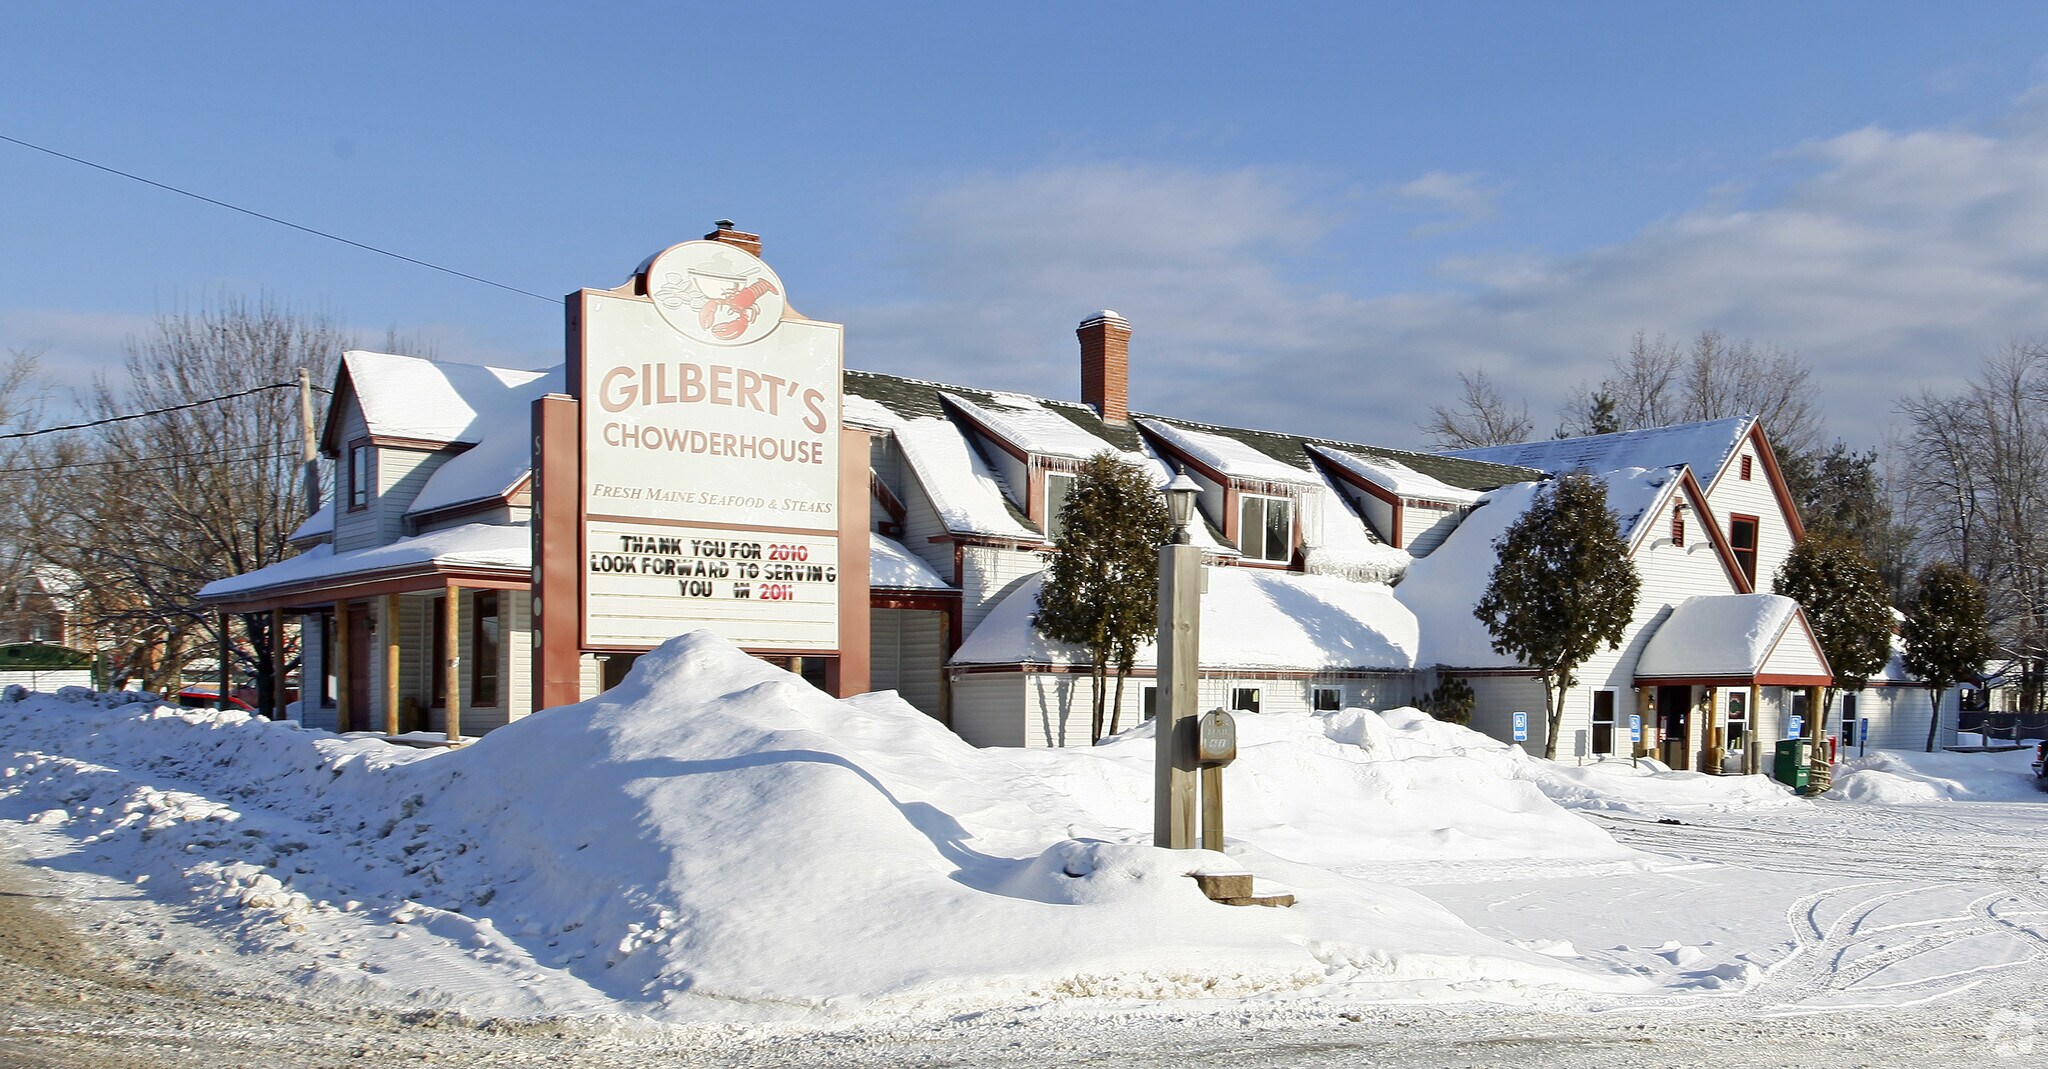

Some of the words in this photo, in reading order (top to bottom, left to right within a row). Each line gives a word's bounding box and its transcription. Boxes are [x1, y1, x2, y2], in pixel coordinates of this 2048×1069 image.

[598, 362, 828, 435] GILBERT'S
[603, 422, 823, 464] CHOWDERHOUSE
[592, 483, 643, 500] FRESH
[645, 487, 696, 503] MAINE
[698, 491, 765, 509] SEAFOOD
[767, 498, 778, 509] &
[781, 498, 833, 513] STEAKS
[620, 535, 682, 555] THANK
[690, 538, 726, 558] YOU
[730, 542, 762, 560] FOR
[767, 543, 809, 562] 2010
[590, 554, 637, 574] LOOK
[642, 557, 730, 578] FORWARD
[736, 562, 760, 579] TO
[764, 563, 837, 583] SERVING
[678, 580, 713, 597] YOU
[733, 582, 750, 599] IN
[759, 583, 794, 601] 2011
